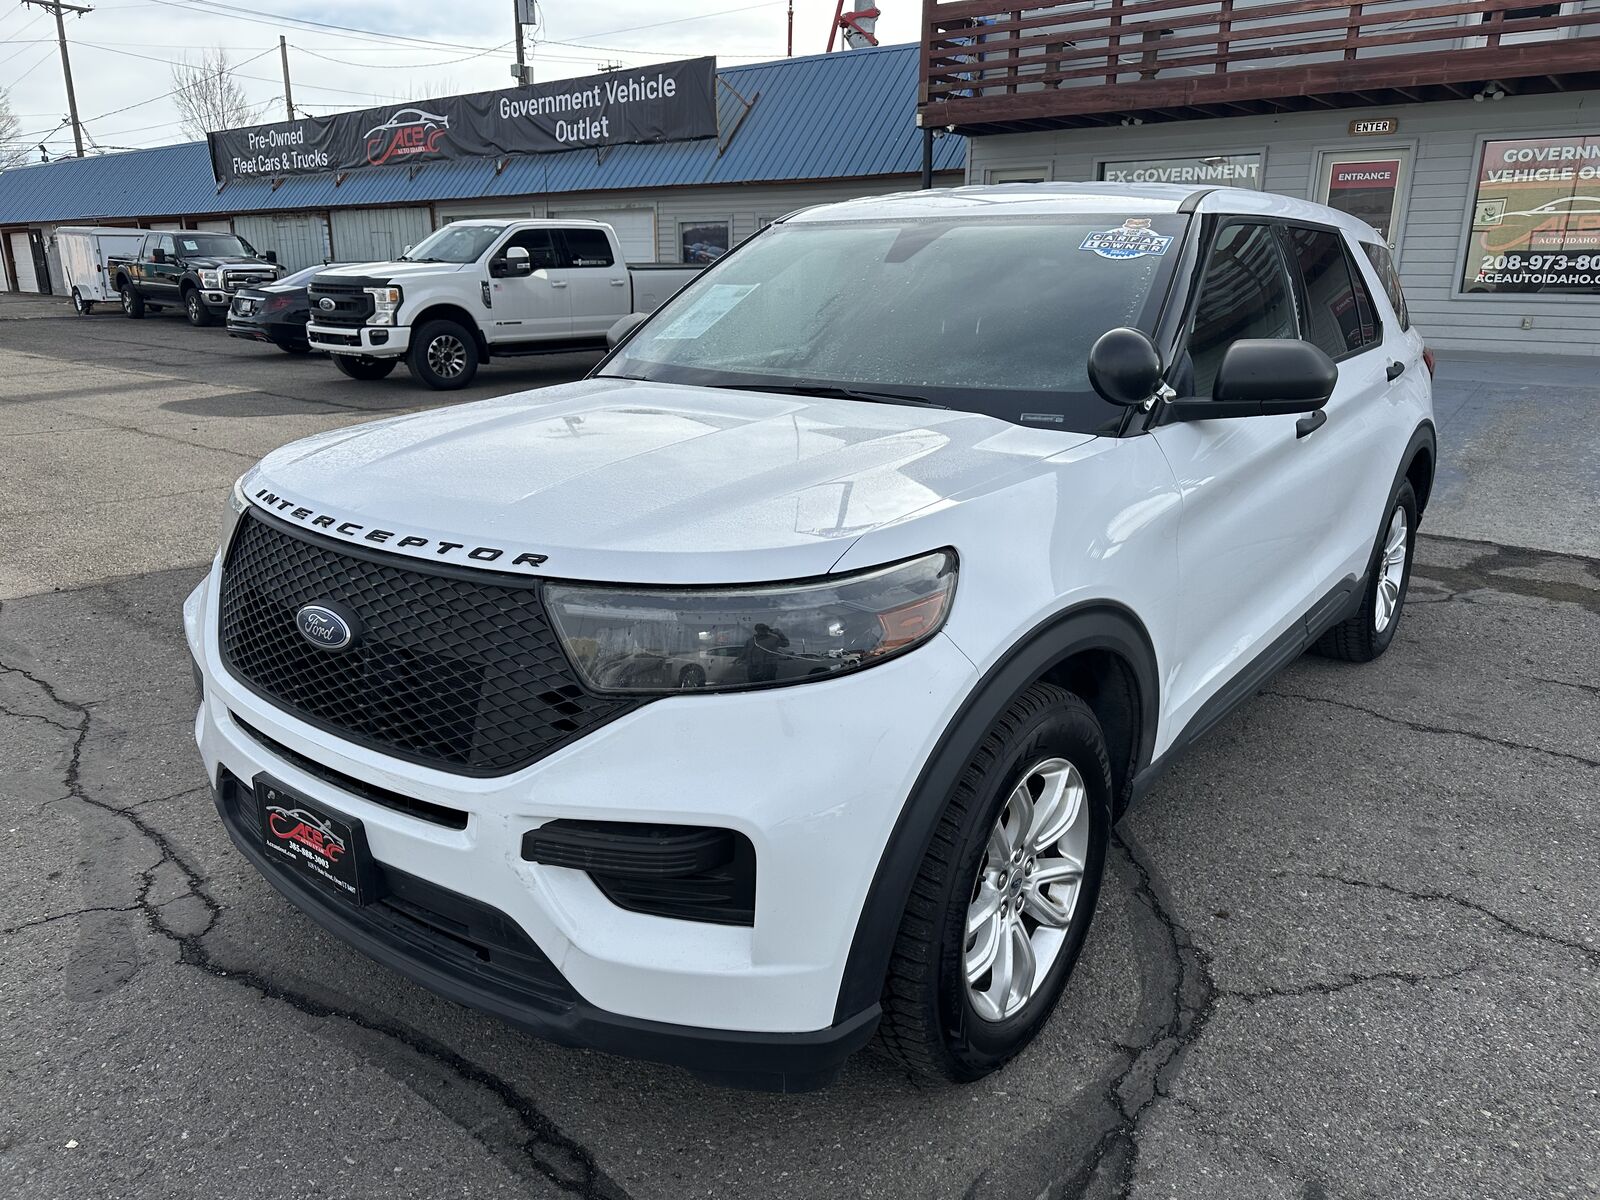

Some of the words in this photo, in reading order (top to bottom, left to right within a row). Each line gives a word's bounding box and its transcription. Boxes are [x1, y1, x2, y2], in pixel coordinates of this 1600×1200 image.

[500, 85, 601, 119] Government
[605, 74, 676, 104] Vehicle
[555, 116, 609, 142] Outlet
[1356, 122, 1389, 132] ENTER
[248, 126, 304, 150] Pre-Owned
[233, 157, 257, 174] Fleet
[258, 155, 280, 172] Cars
[282, 152, 290, 169] &
[291, 149, 328, 169] Trucks
[1106, 164, 1259, 182] EX-GOVERNMENT
[1338, 171, 1391, 181] ENTRANCE
[1488, 167, 1574, 183] VEHICLE
[1092, 234, 1164, 246] CARFAX
[1100, 242, 1161, 252] OWNER
[255, 489, 549, 567] INTERCEPTOR
[305, 613, 335, 640] Ford
